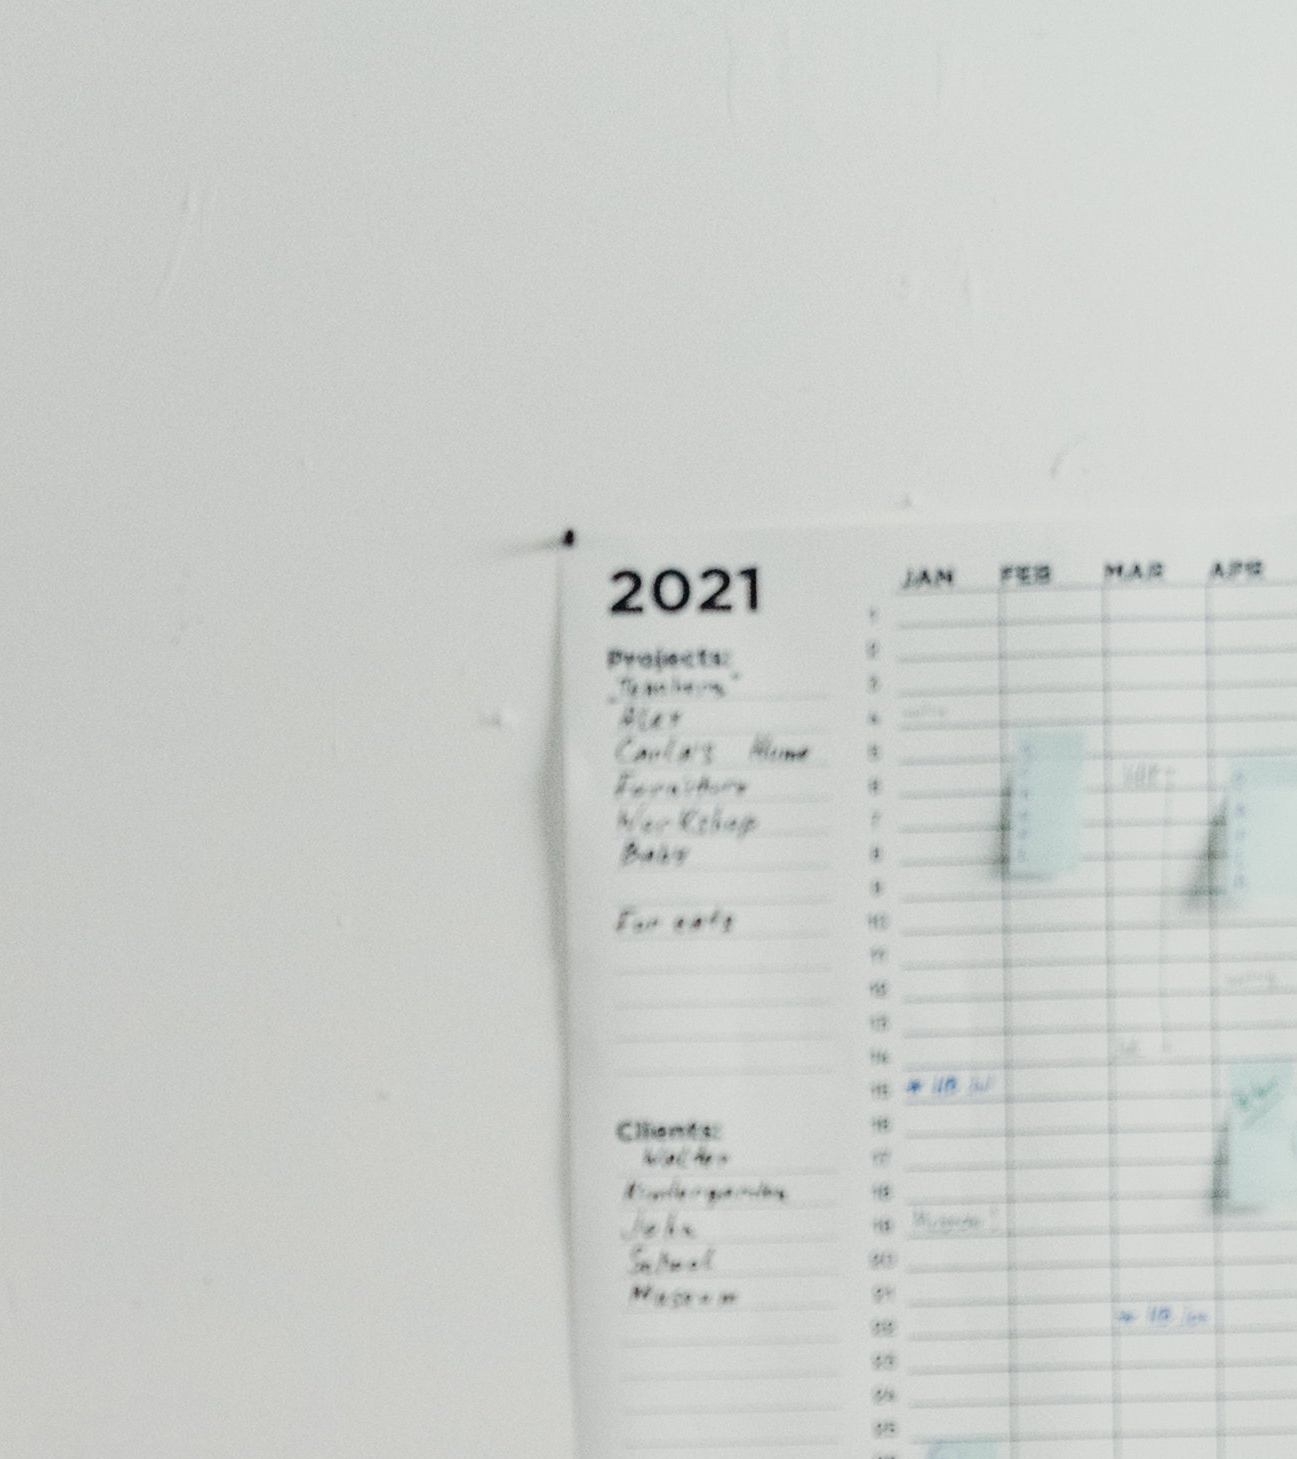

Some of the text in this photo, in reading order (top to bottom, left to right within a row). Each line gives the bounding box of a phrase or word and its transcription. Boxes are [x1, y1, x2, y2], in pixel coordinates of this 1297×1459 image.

[609, 566, 759, 615] 2021
[901, 559, 1264, 587] JAN FEB MAR APR
